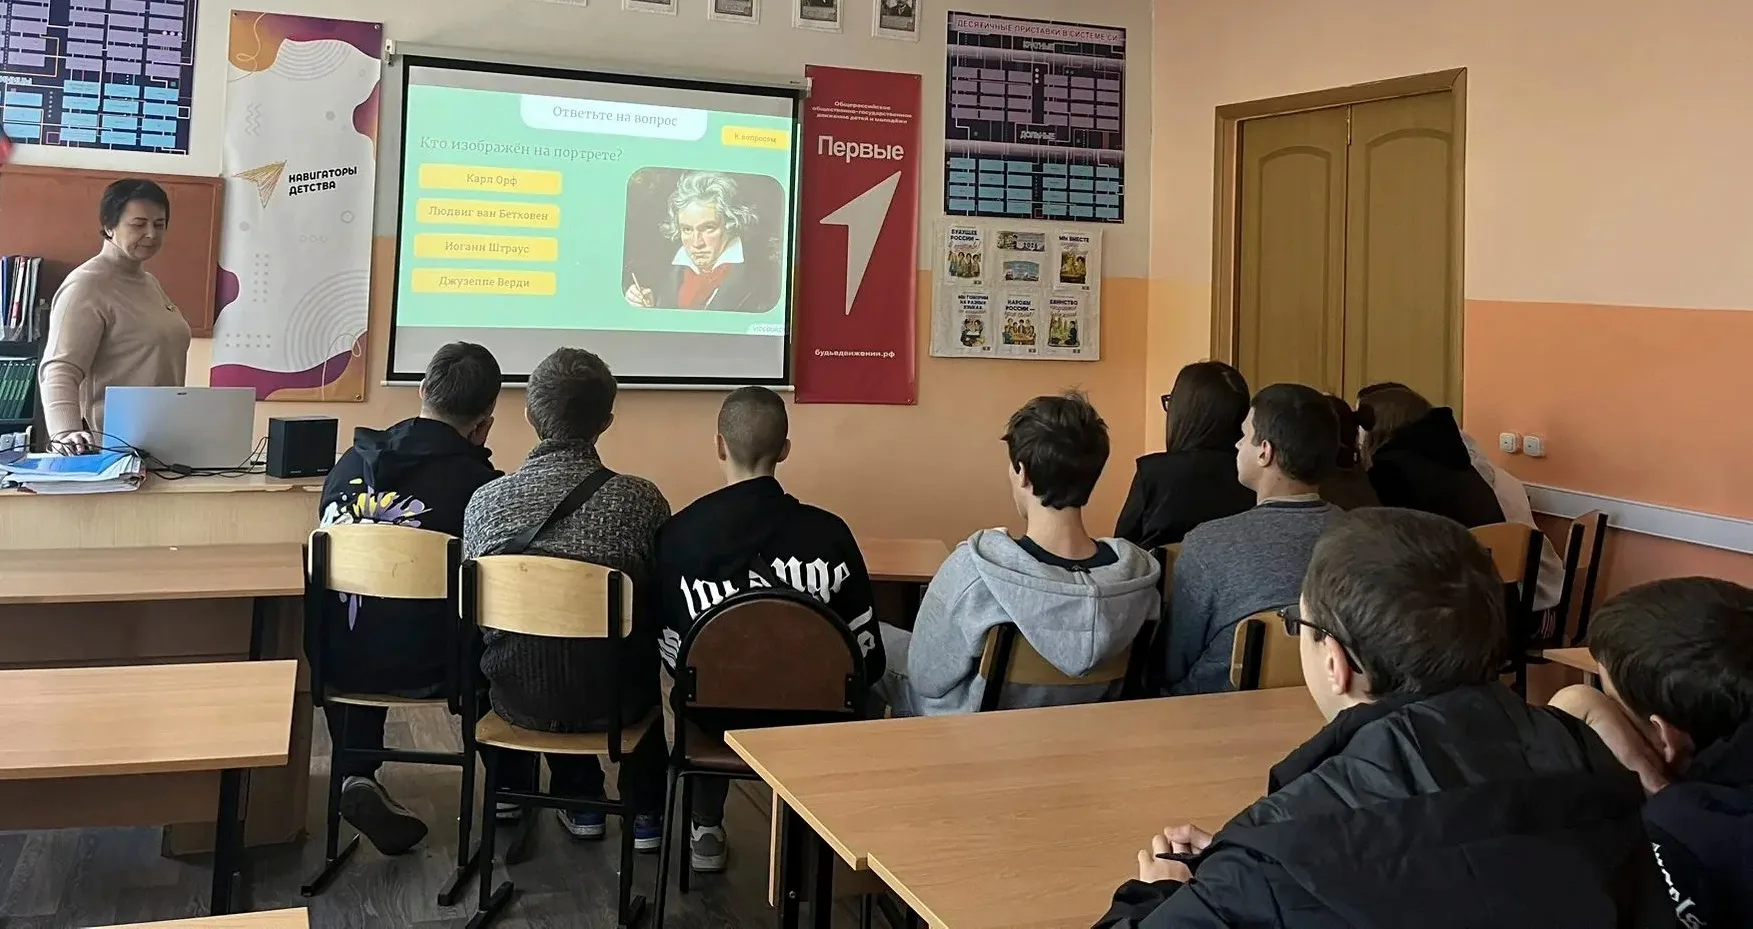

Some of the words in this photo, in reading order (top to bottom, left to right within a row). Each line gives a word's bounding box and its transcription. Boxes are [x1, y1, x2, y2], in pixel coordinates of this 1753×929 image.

[957, 19, 1012, 32] ДЕСЯТИЧНЫЕ
[1014, 24, 1060, 36] ПРИСТАВКИ
[1070, 30, 1104, 40] СИСТЕМЕ
[834, 101, 891, 110] Общероссийское
[552, 105, 613, 121] Ответьте
[616, 112, 631, 122] на
[634, 114, 678, 128] вопрос
[420, 136, 447, 149] Кто
[451, 140, 530, 155] изображён
[534, 146, 550, 156] на
[554, 148, 623, 162] портрете?
[818, 135, 904, 163] Первые
[289, 166, 357, 184] НАВИГАТОРЫ
[466, 174, 493, 185] Карл
[496, 176, 518, 187] Орф
[289, 181, 336, 196] ДЕТСТВА
[428, 206, 474, 217] Людвиг
[476, 210, 496, 218] ван
[499, 209, 548, 220] Бетховен
[445, 241, 486, 252] Иоганн
[488, 242, 530, 255] Штраус
[438, 276, 494, 288] Джузеппе
[497, 278, 530, 288] Верди
[814, 348, 896, 358] будьедвижении.рф
